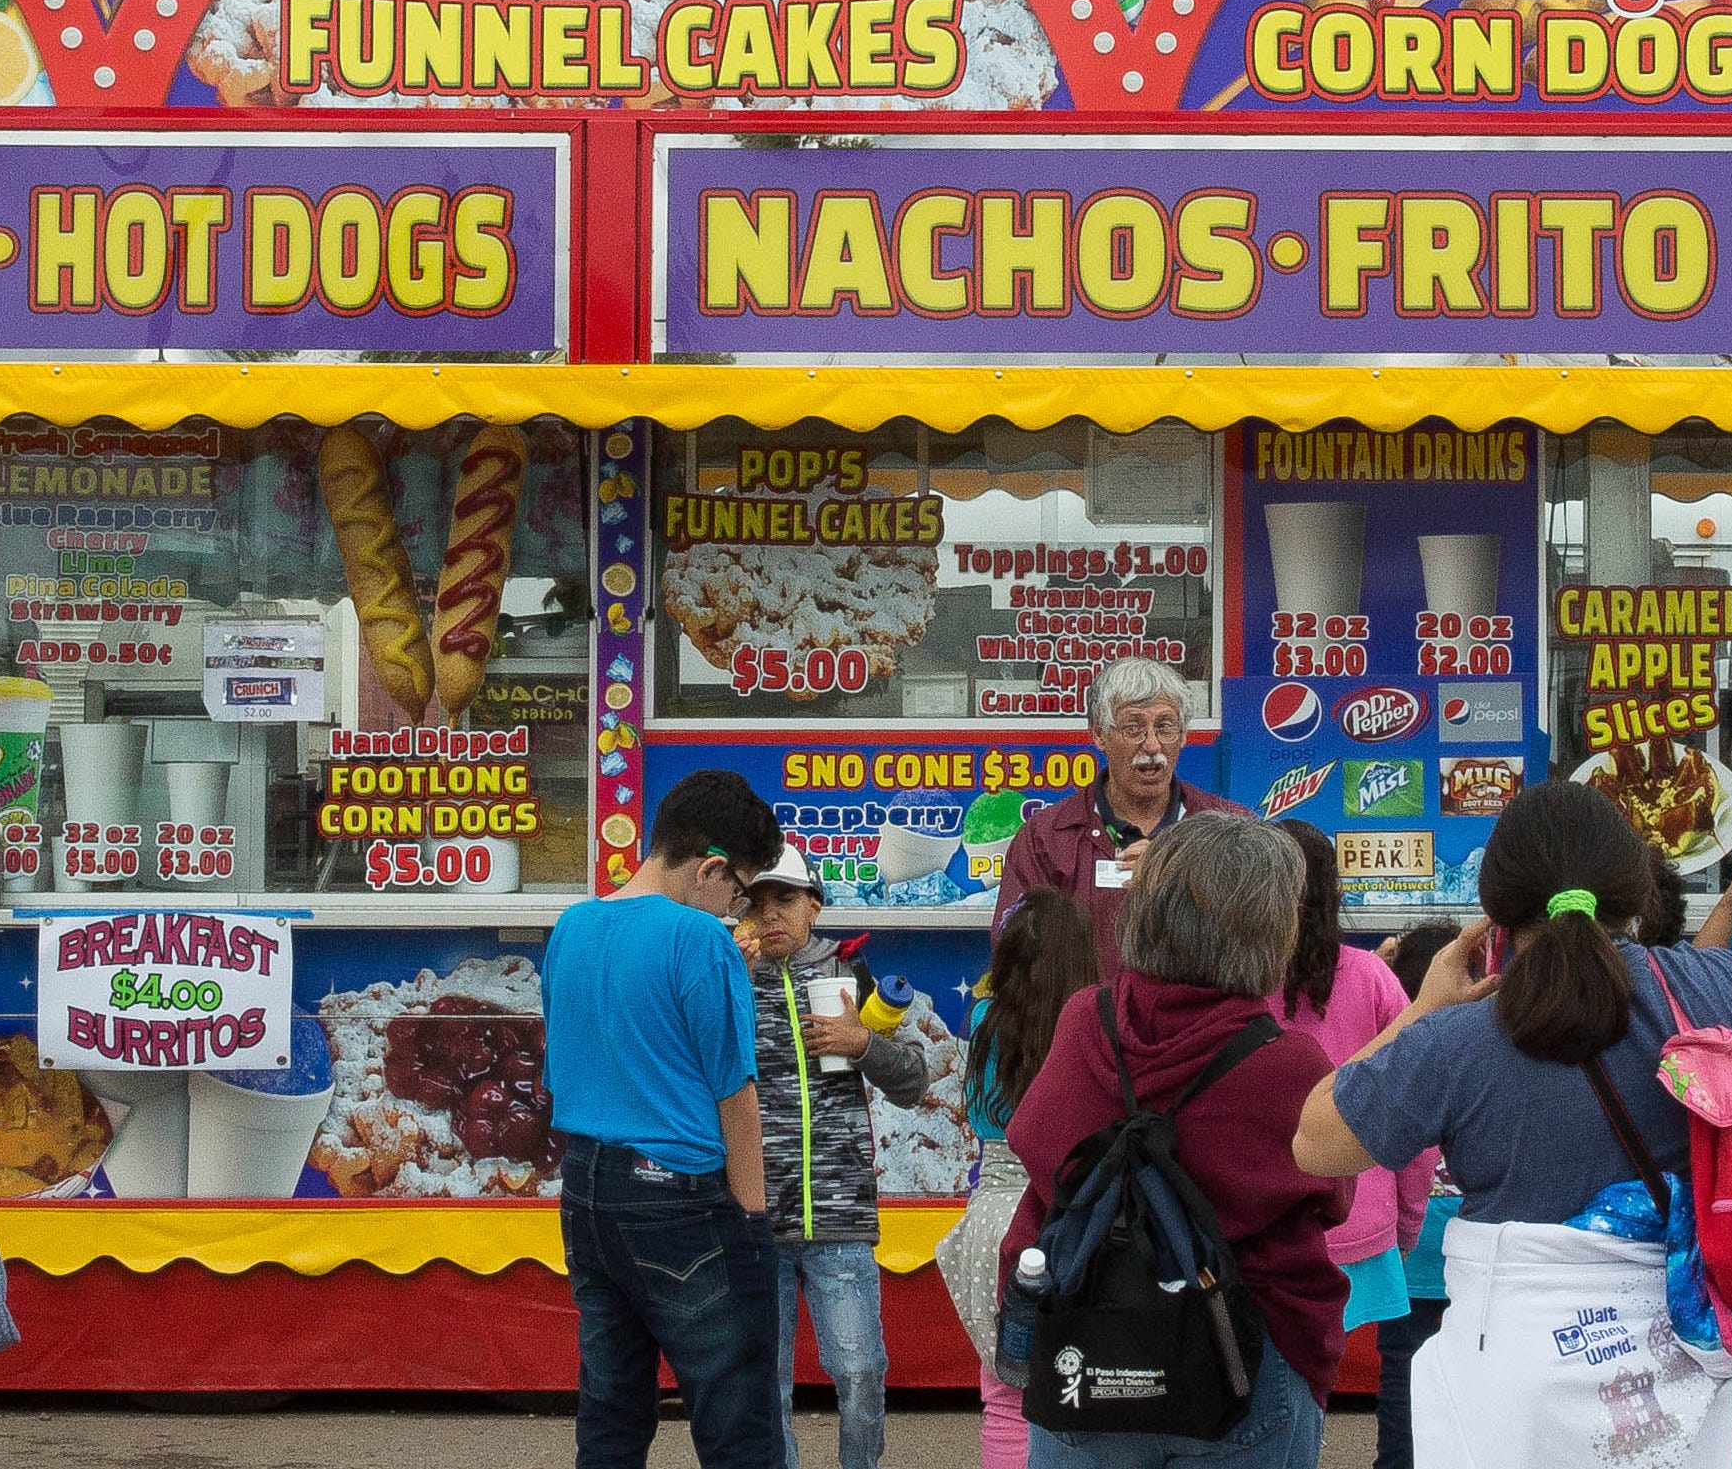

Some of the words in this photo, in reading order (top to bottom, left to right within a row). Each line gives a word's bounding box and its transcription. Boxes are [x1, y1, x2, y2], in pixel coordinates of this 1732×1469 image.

[1251, 6, 1519, 99] CORN
[33, 187, 228, 311] HOT
[248, 187, 513, 315] DOGS
[702, 190, 1260, 317] NACHOS
[1323, 192, 1713, 317] FRITO
[73, 429, 219, 463] Squeezed
[1257, 432, 1405, 481] FOUNTAIN
[1414, 432, 1525, 481] DRINKS
[740, 448, 865, 492] POP'S
[57, 505, 216, 531] Raspberry
[666, 497, 813, 542] FUNNEL
[819, 498, 942, 544] CAKES
[48, 529, 147, 554] Cherry
[62, 552, 134, 574] Lime
[955, 543, 1106, 579] Toppings
[1114, 542, 1208, 575] $1.00
[82, 576, 187, 598] Colada
[1010, 585, 1152, 613] Strawberry
[10, 600, 183, 625] Strawberry
[1017, 611, 1144, 635] Chocolate
[1272, 613, 1317, 638] 32
[1325, 616, 1368, 639] oz
[1417, 613, 1461, 638] 20
[1469, 616, 1512, 639] oz
[18, 642, 81, 663] ADD
[88, 642, 173, 663] 0.50¢
[978, 638, 1053, 661] White
[1057, 638, 1184, 662] Chocolate
[1274, 642, 1366, 676] $3.00
[1418, 643, 1511, 675] $2.00
[732, 644, 867, 695] $5.00
[1043, 665, 1101, 690] Appl
[1588, 642, 1714, 690] APPLE
[234, 684, 279, 696] CRUNCH
[982, 690, 1085, 714] Caramel
[244, 707, 272, 718] $2.00
[512, 707, 573, 721] station
[1352, 700, 1412, 736] Pepper
[1370, 694, 1395, 716] Dr
[1474, 707, 1518, 722] pepsi
[1585, 693, 1717, 750] Slices
[331, 728, 411, 756] Hand
[417, 727, 527, 759] Dipped
[329, 763, 530, 798] FOOTLONG
[785, 752, 865, 788] SNO
[873, 752, 973, 788] CONE
[982, 749, 1097, 792] $3.00
[1454, 767, 1511, 791] MUG
[1358, 765, 1409, 812] Mist
[320, 802, 425, 837] CORN
[433, 801, 541, 837] DOGS
[775, 804, 962, 831] Raspberry
[6, 823, 42, 844] oz
[65, 823, 99, 845] 32
[106, 825, 140, 845] oz
[157, 823, 195, 845] 20
[200, 825, 235, 846] oz
[786, 832, 881, 858] herry
[1344, 839, 1403, 848] GOLD
[66, 848, 139, 877] $5.00
[159, 848, 233, 879] $3.00
[367, 841, 493, 890] $5.00
[1344, 850, 1403, 868] PEAK
[1341, 881, 1368, 891] weet
[58, 913, 279, 977] BREAKFAST
[110, 969, 223, 1011] $4.00
[67, 1005, 267, 1067] BURRITOS
[1577, 1306, 1617, 1327] Walt
[1095, 1367, 1115, 1377] Paso
[1116, 1368, 1165, 1378] Independent
[1097, 1377, 1124, 1386] School
[1126, 1377, 1155, 1386] District
[1091, 1388, 1119, 1396] SPECIAL
